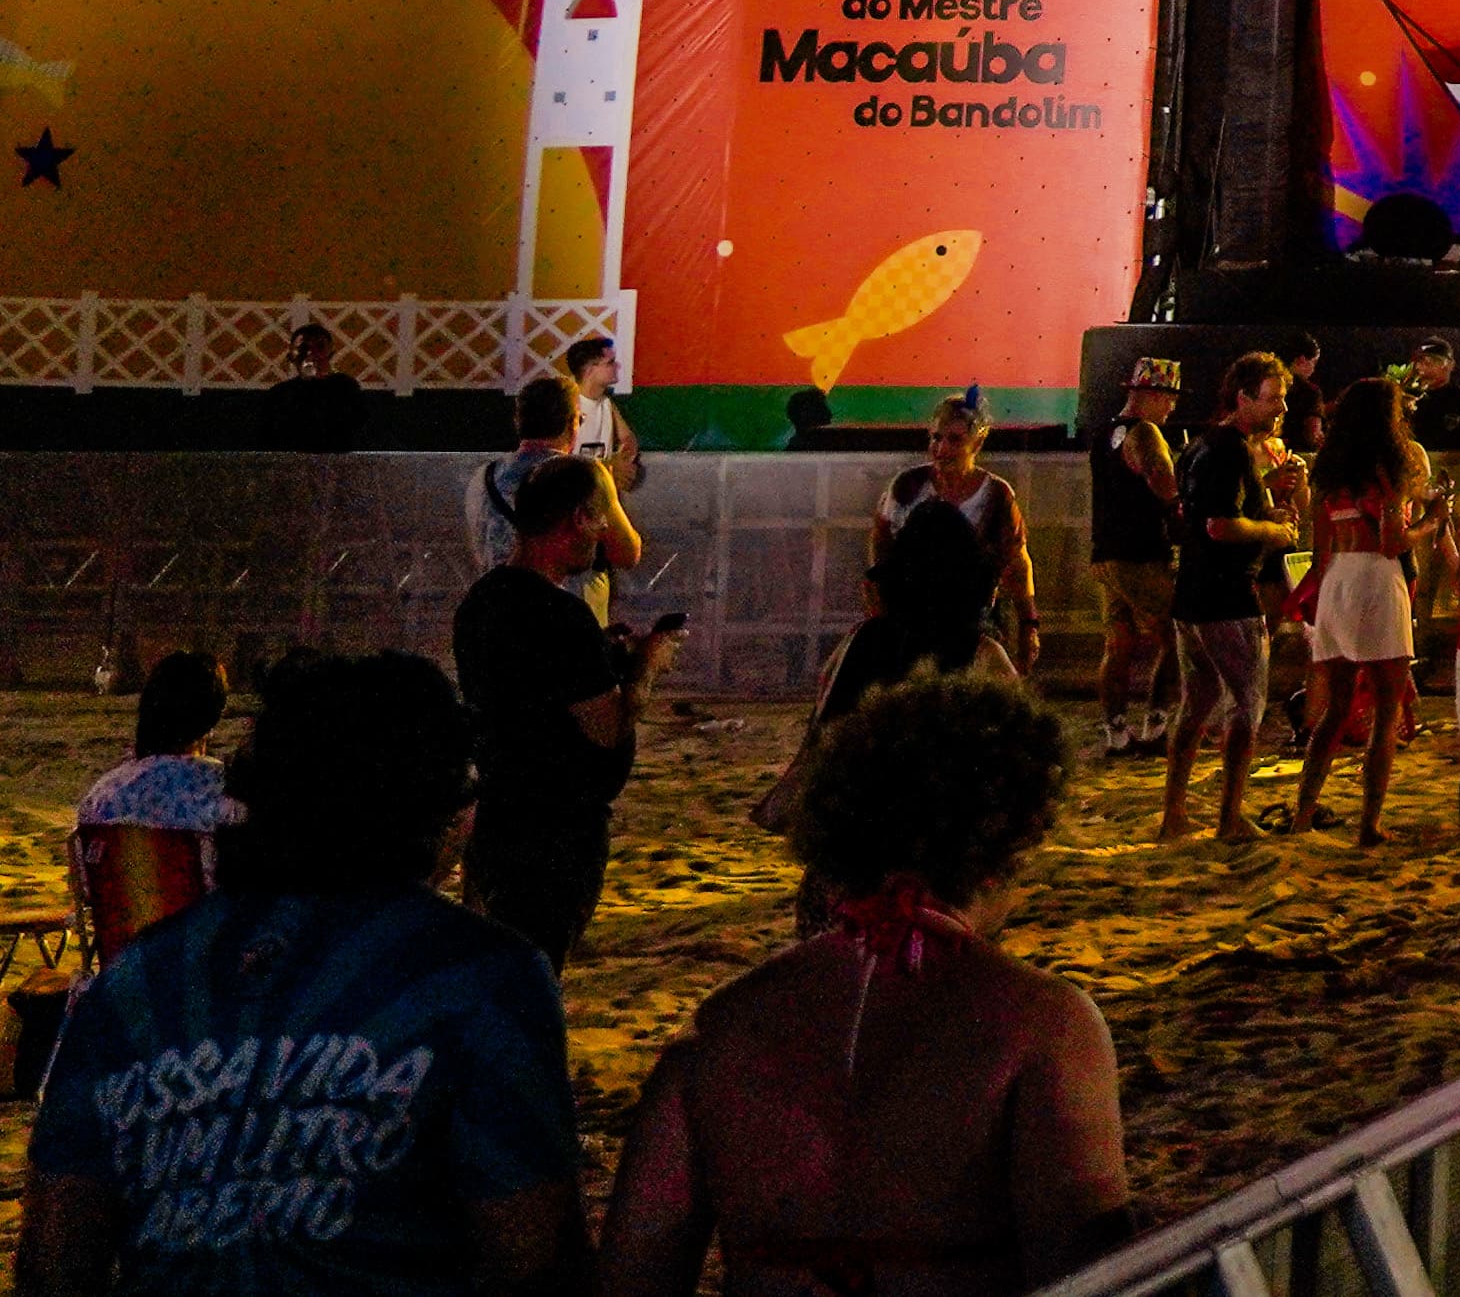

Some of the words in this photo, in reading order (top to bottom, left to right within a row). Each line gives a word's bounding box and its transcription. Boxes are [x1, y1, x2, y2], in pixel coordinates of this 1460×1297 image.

[759, 27, 1067, 84] Macaúba
[854, 95, 902, 127] do
[910, 94, 1102, 129] Bandolim
[263, 1034, 433, 1105] VIDA
